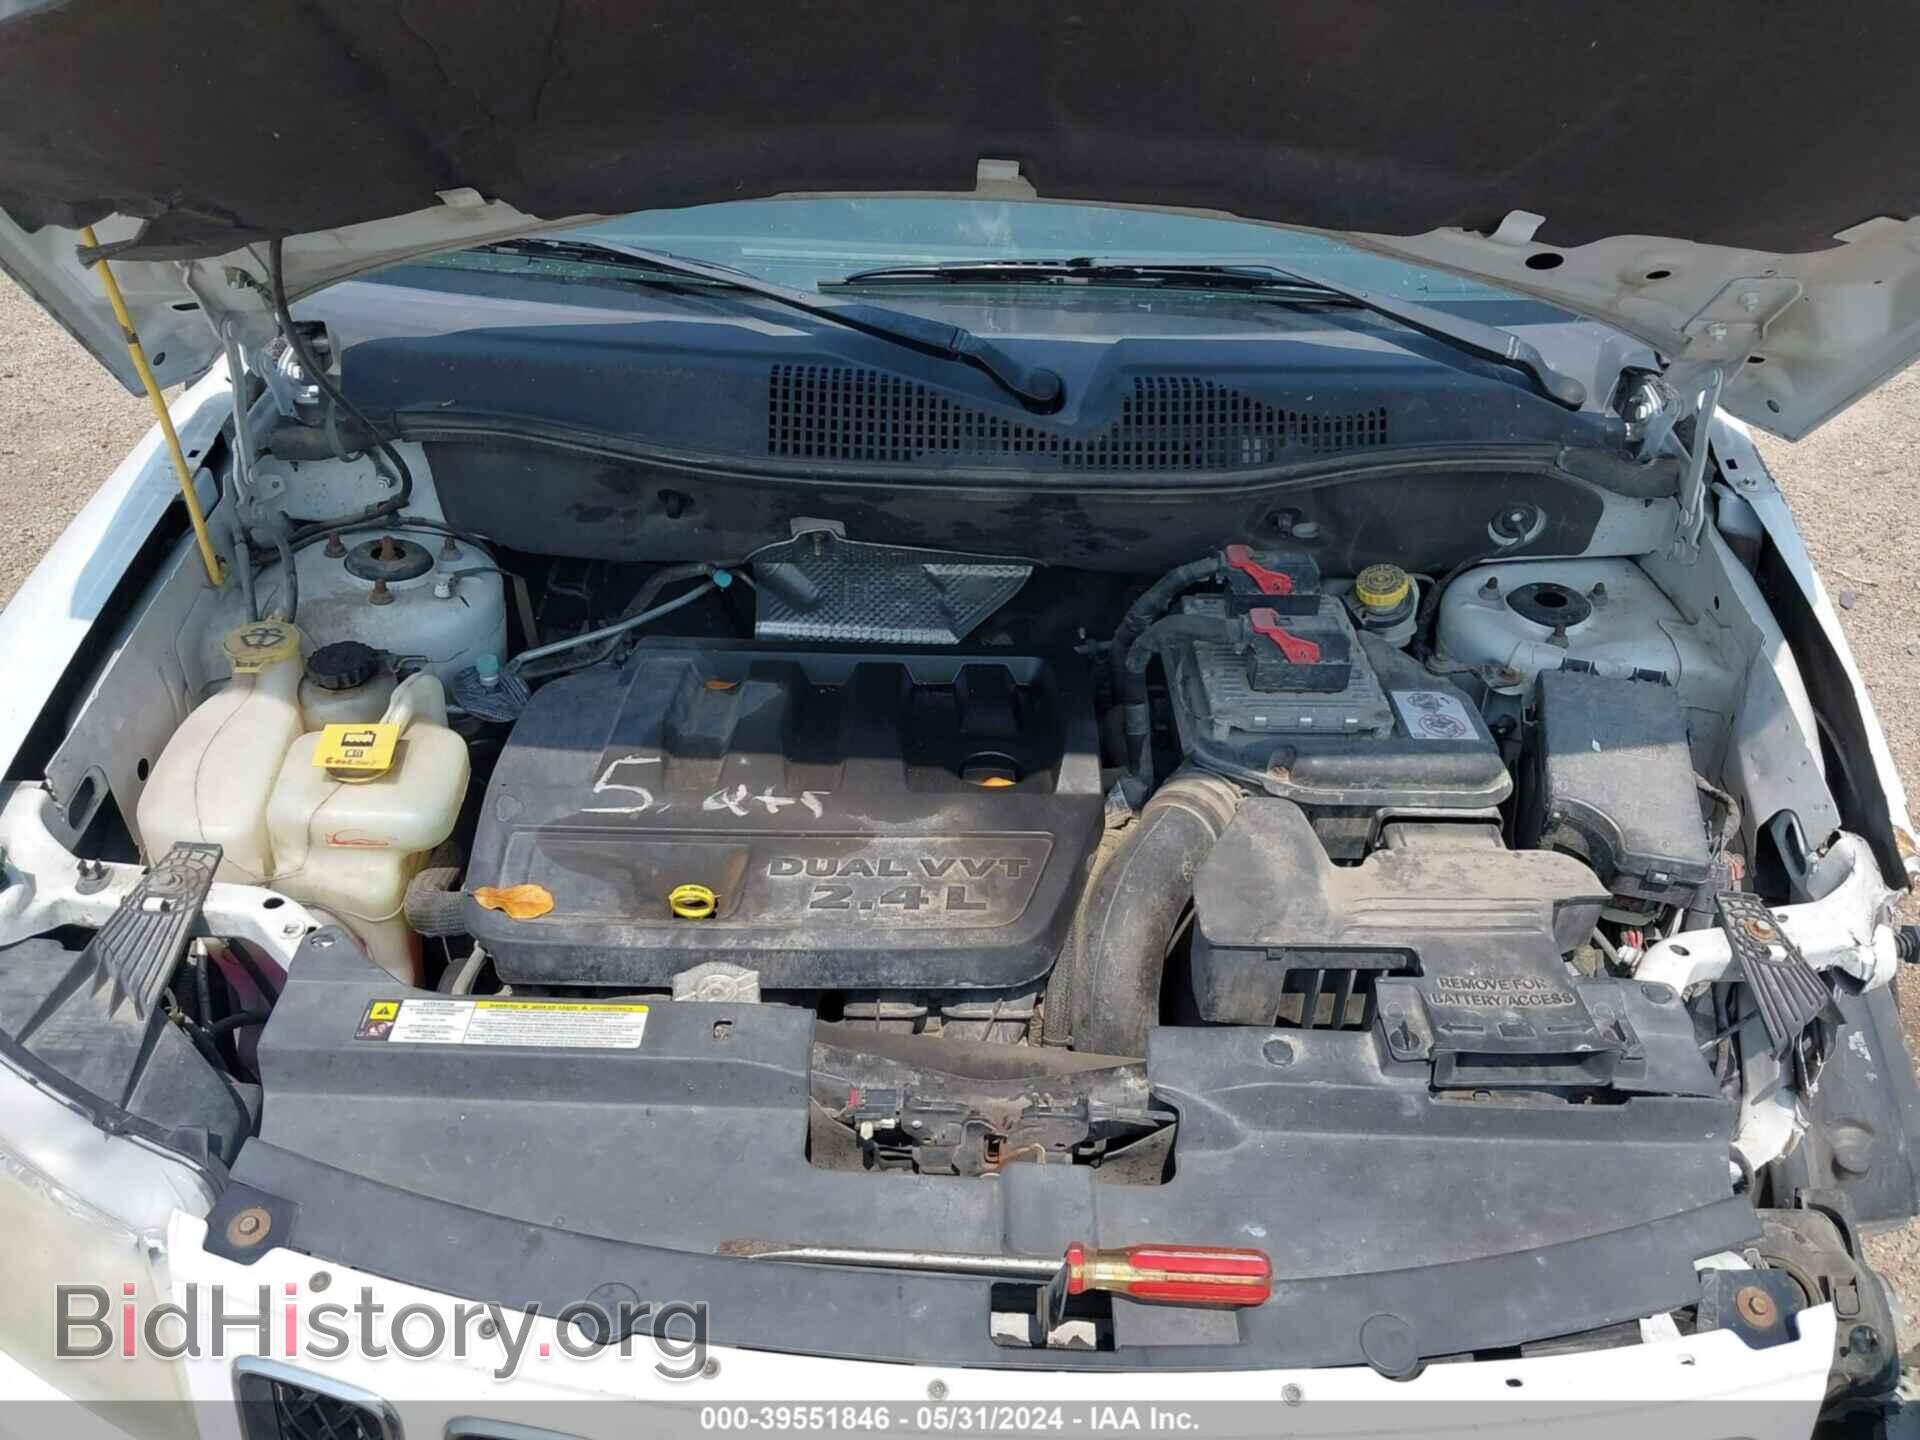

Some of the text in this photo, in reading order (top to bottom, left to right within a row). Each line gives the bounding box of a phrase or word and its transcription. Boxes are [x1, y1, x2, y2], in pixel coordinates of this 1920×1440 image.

[767, 857, 1031, 879] DUAL VVT
[1438, 976, 1549, 992] REMOVE FOR
[1430, 991, 1576, 1008] BATTERY ACCESS
